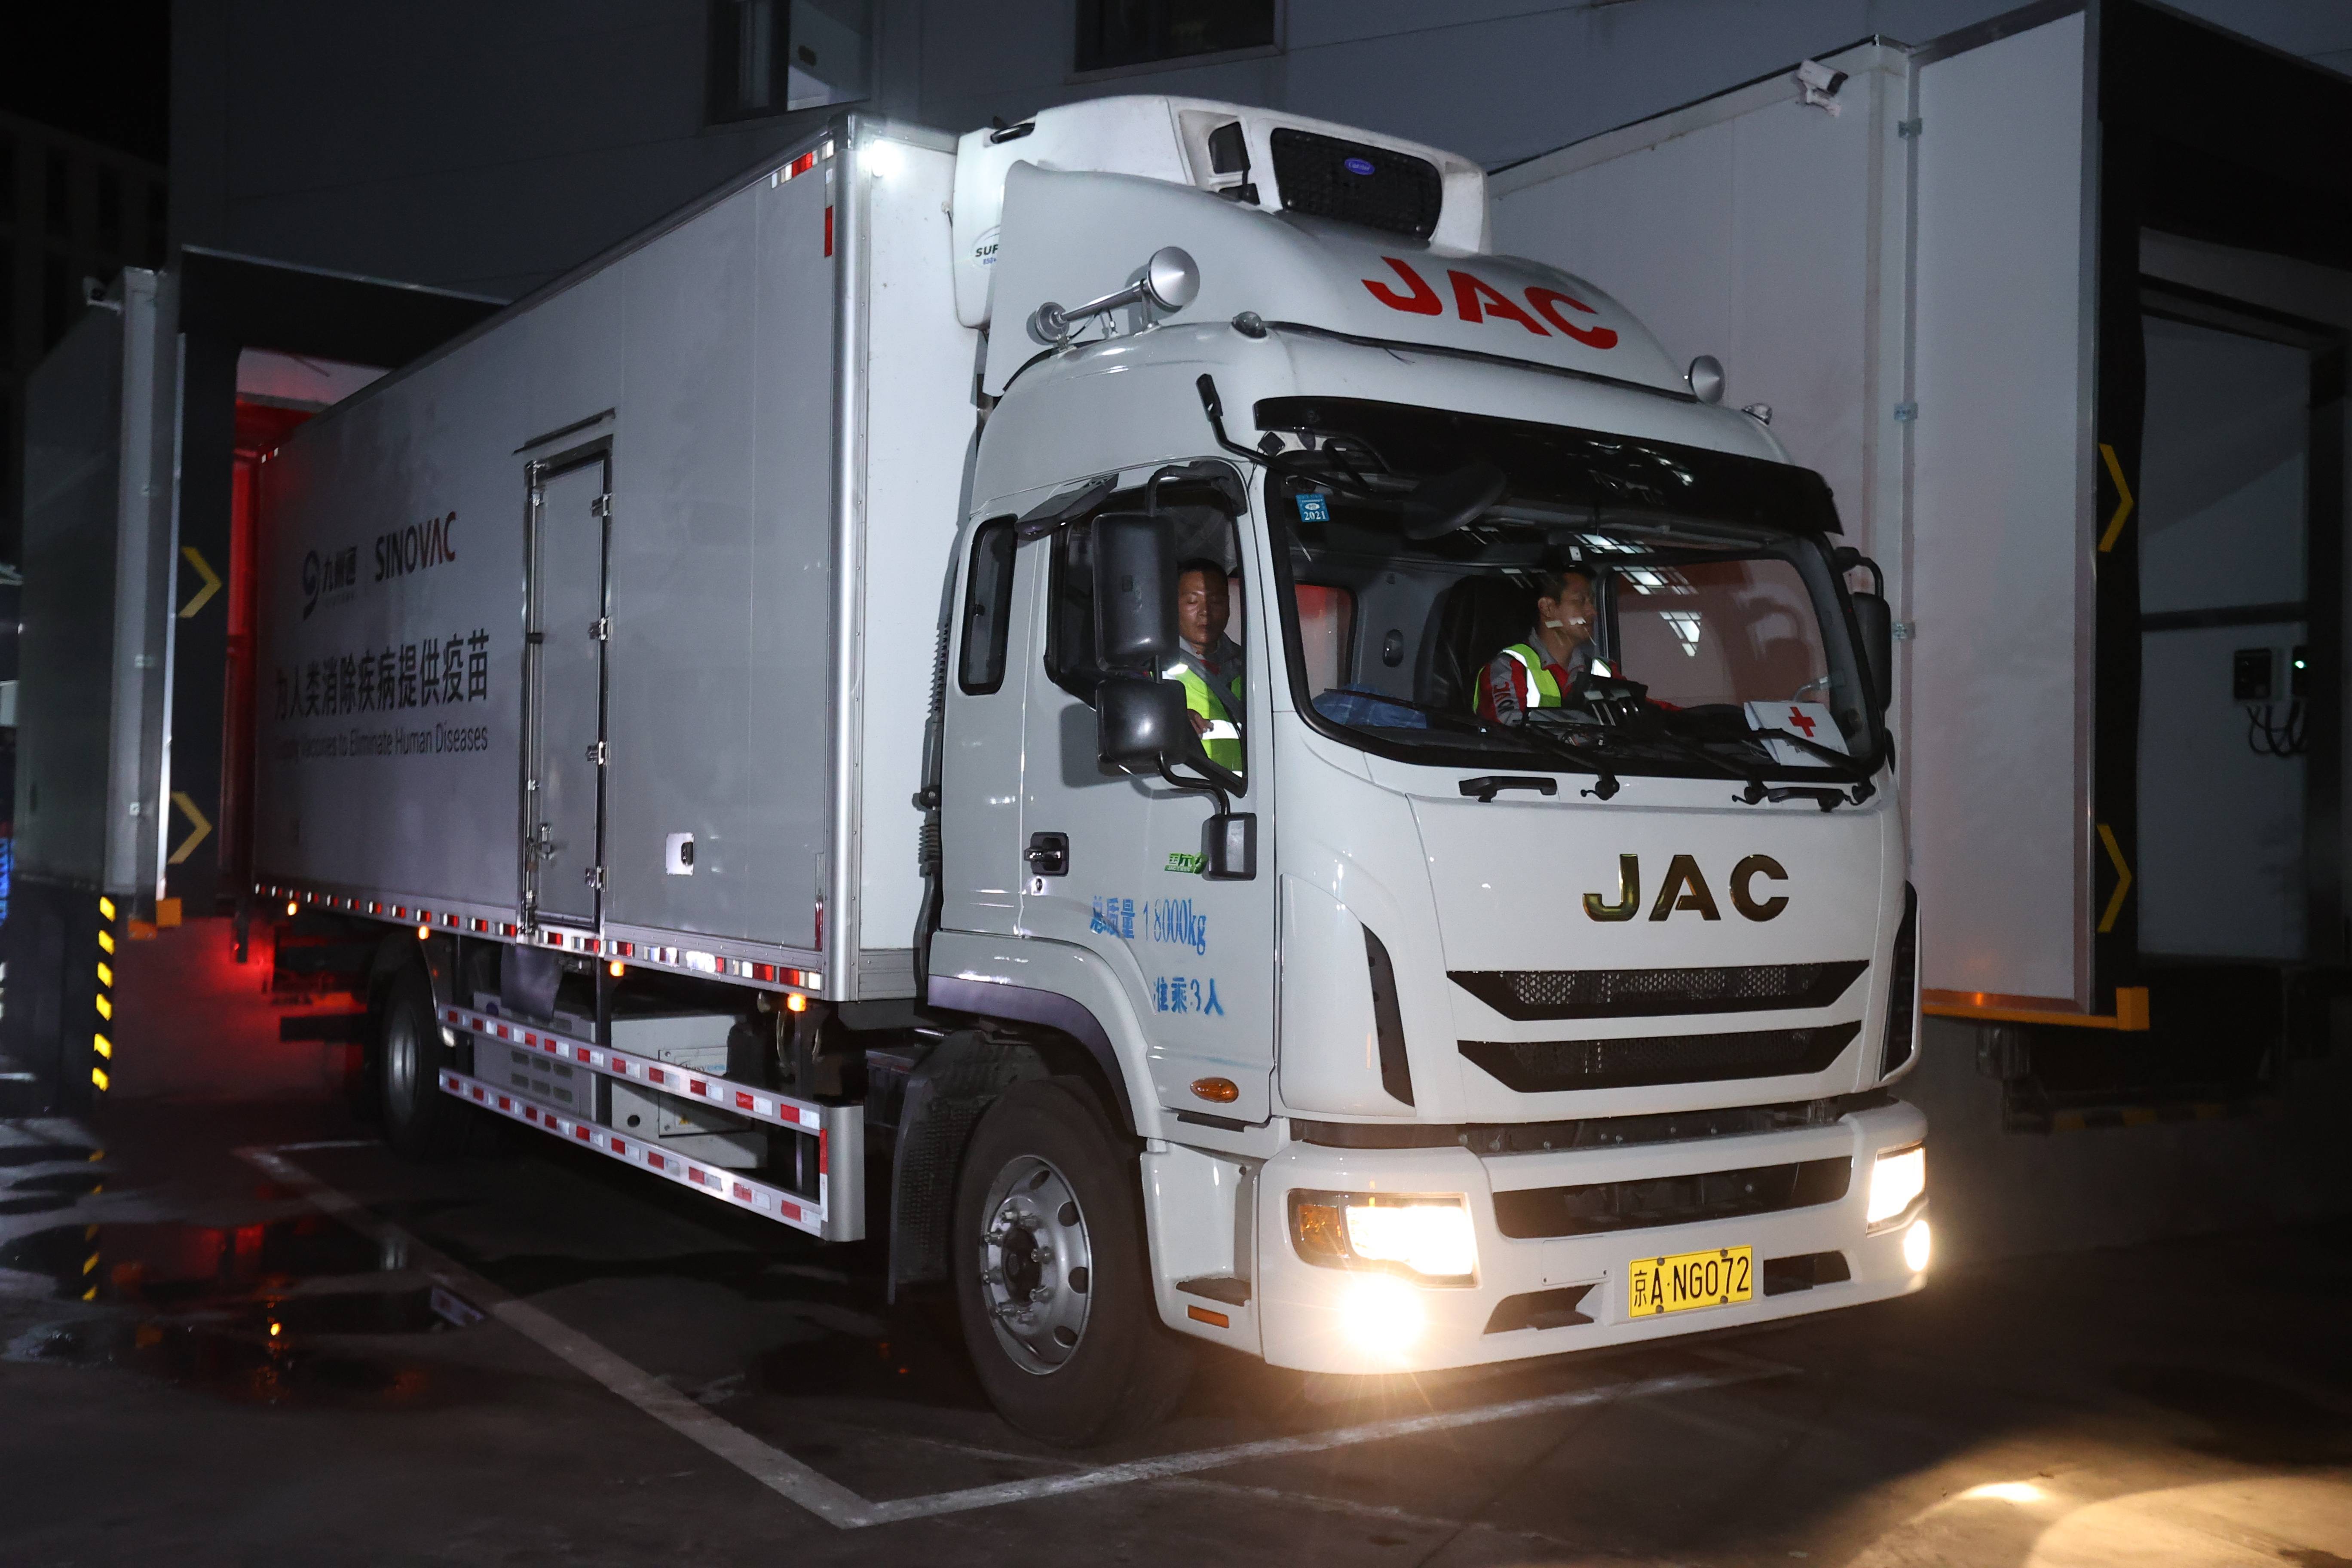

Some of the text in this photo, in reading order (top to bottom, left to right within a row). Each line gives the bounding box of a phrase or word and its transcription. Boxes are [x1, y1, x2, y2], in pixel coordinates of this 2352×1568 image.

[1361, 256, 1618, 349] JAC
[375, 511, 456, 582] SINOVAC
[1303, 510, 1326, 521] 2021
[395, 726, 432, 756] Human
[436, 720, 488, 753] Diseases
[1582, 854, 1789, 922] JAC
